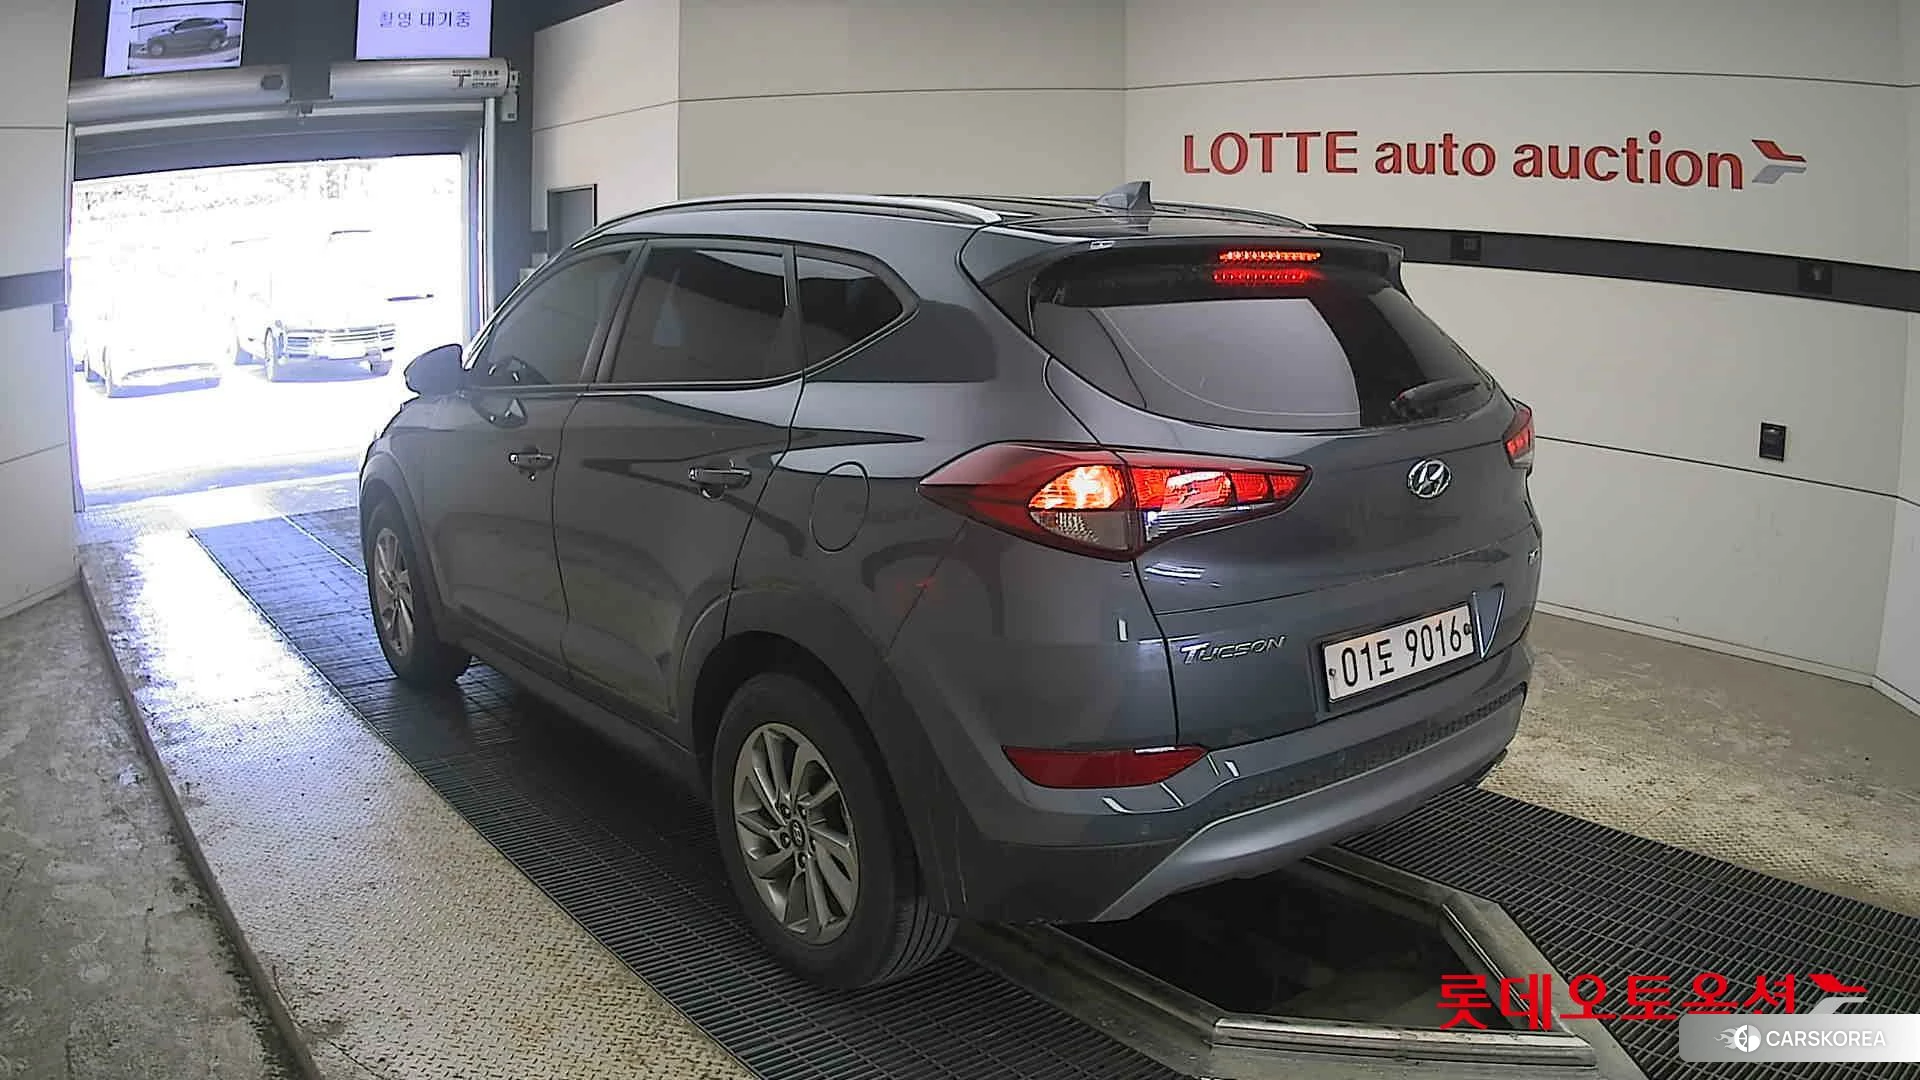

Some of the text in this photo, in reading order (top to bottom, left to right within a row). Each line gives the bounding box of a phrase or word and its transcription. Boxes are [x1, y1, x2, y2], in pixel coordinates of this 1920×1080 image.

[419, 11, 470, 28] 대기중
[1183, 129, 1744, 190] LOTTE auto auction
[1341, 615, 1462, 687] 01도 9016
